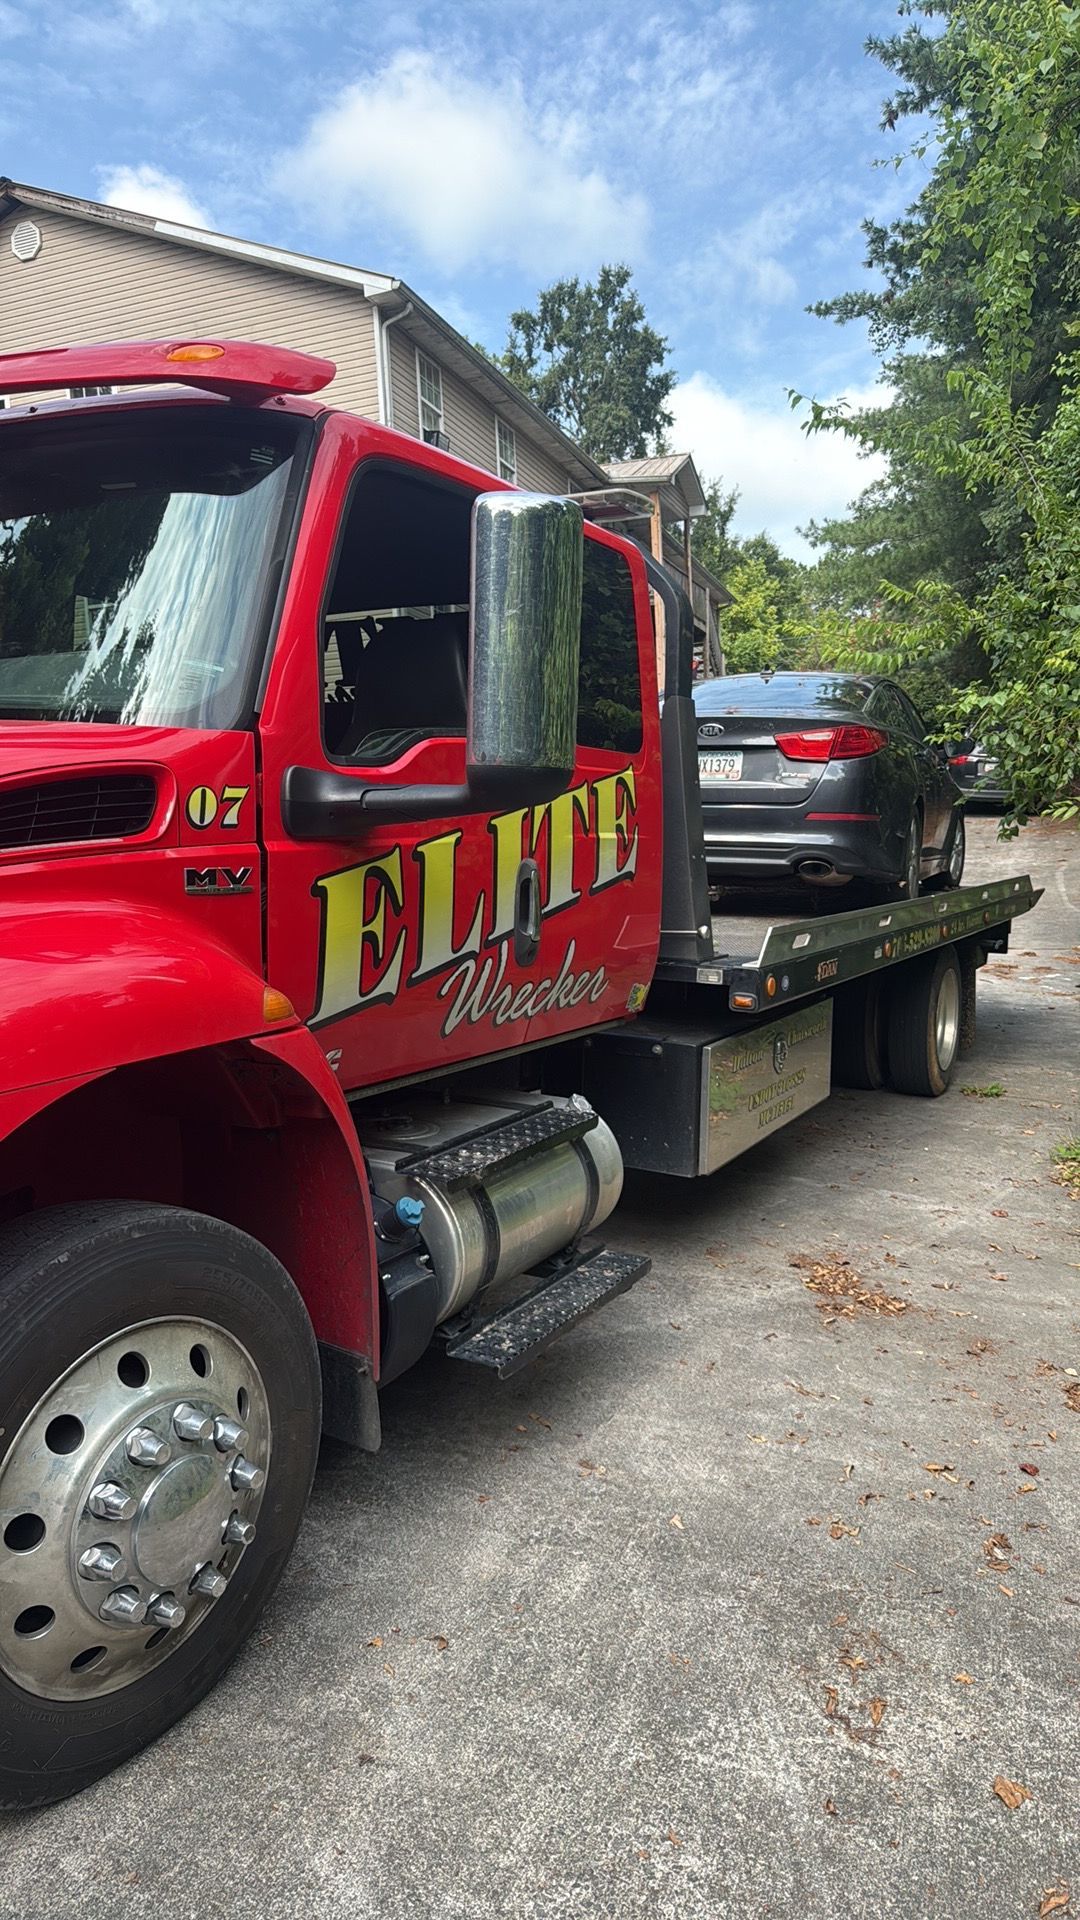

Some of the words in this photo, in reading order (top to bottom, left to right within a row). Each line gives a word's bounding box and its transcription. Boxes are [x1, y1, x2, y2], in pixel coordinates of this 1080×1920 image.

[701, 725, 720, 736] KIA
[185, 785, 250, 830] 07
[184, 866, 254, 888] MV
[306, 764, 641, 1031] ELITE
[438, 939, 609, 1038] Wrecker
